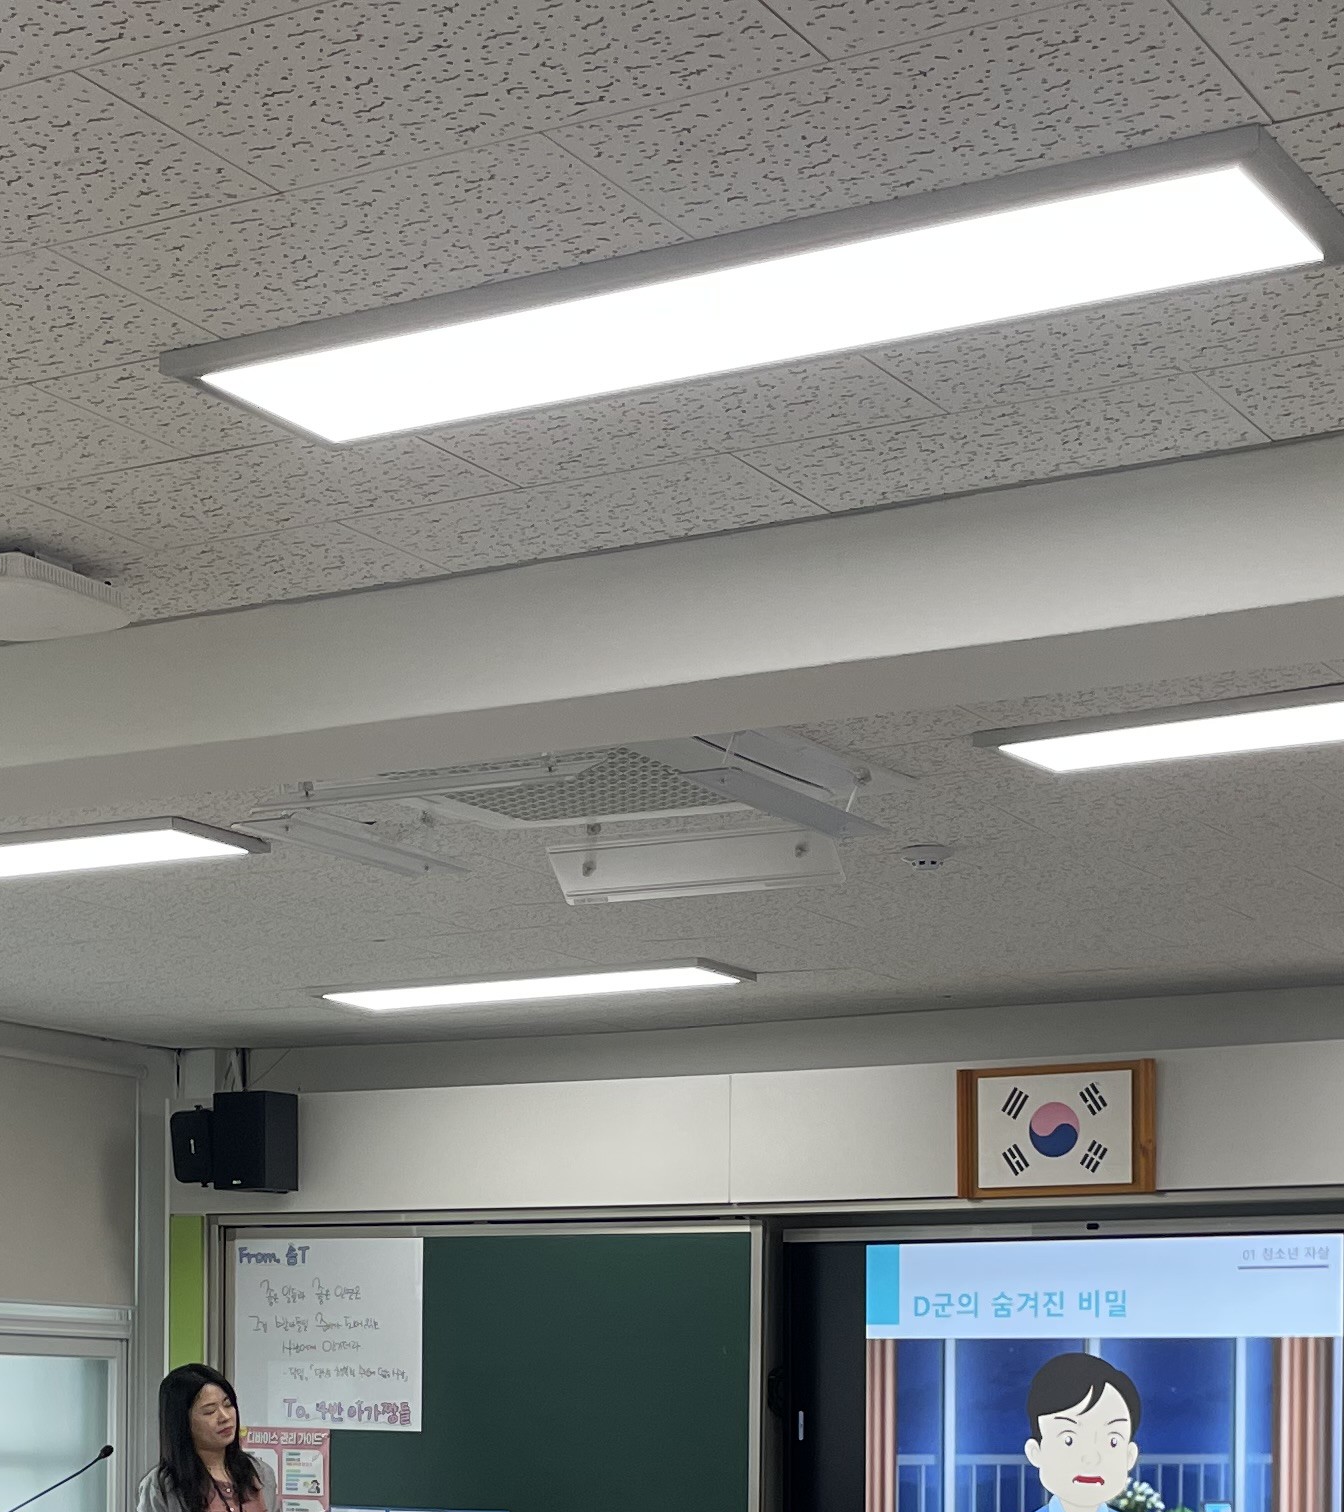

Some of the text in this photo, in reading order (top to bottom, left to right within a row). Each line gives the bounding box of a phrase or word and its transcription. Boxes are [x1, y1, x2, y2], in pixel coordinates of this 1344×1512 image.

[238, 1246, 281, 1264] From.
[1263, 1247, 1299, 1261] 청소년
[1304, 1245, 1330, 1260] 자살
[913, 1289, 1127, 1318] D군의 숨겨진 비밀
[283, 1399, 310, 1420] To.
[347, 1401, 411, 1425] 아가짱들
[247, 1430, 323, 1446] 디바이스 관리 가이드
